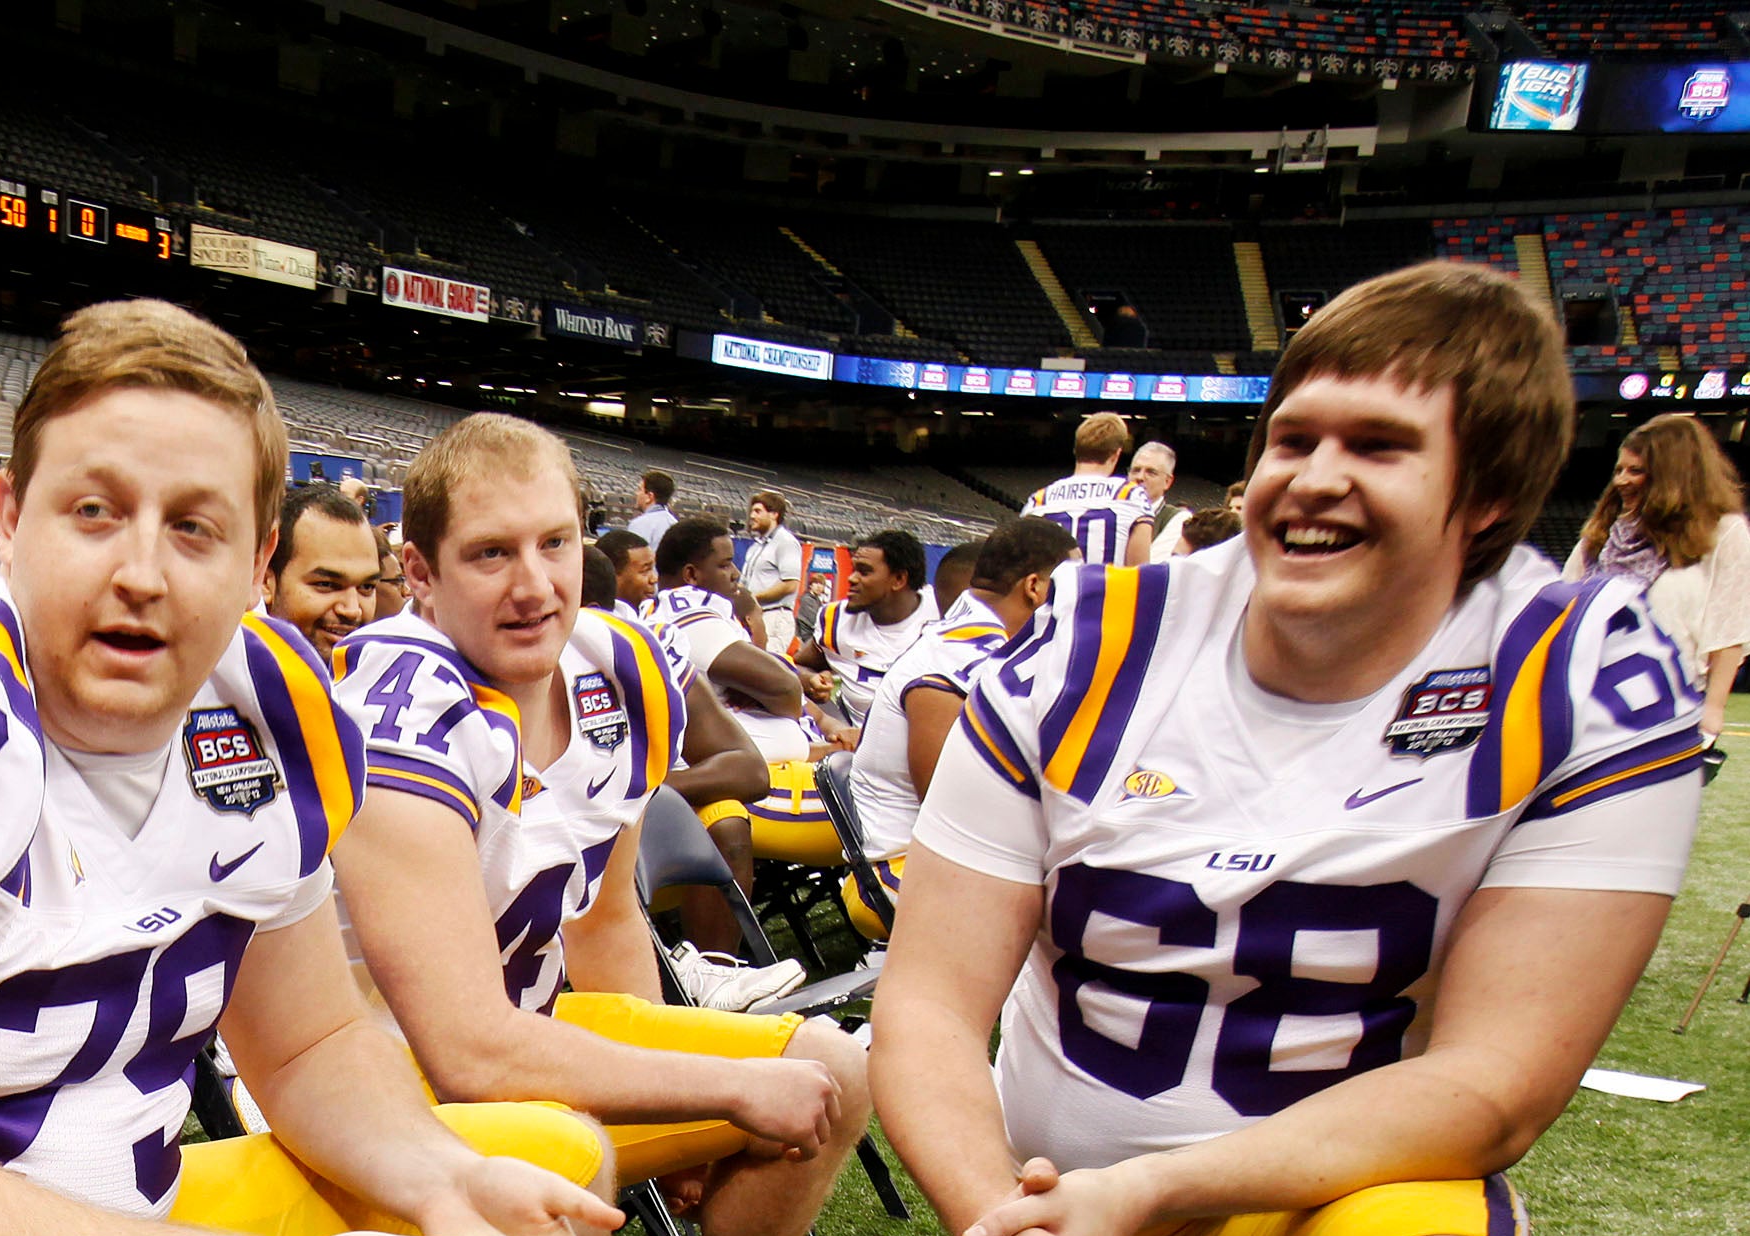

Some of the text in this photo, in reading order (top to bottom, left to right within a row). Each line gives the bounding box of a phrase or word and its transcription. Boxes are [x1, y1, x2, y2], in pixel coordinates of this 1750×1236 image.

[1512, 79, 1571, 97] LIGHT
[1521, 66, 1572, 84] BUD
[0, 195, 27, 228] 50
[49, 208, 57, 233] 1
[81, 208, 96, 237] 0
[157, 231, 170, 260] 3
[403, 273, 476, 314] NATIONAL GUARD
[555, 307, 635, 342] WHITNEY BANK
[1048, 482, 1114, 501] HAIRSTON
[363, 650, 483, 755] 47
[580, 692, 612, 713] BCS
[1412, 688, 1487, 715] BCS
[196, 711, 238, 731] Allstate
[197, 734, 251, 763] BCS
[1134, 773, 1163, 796] SEC
[1205, 852, 1277, 873] LSU
[1051, 864, 1438, 1118] 68
